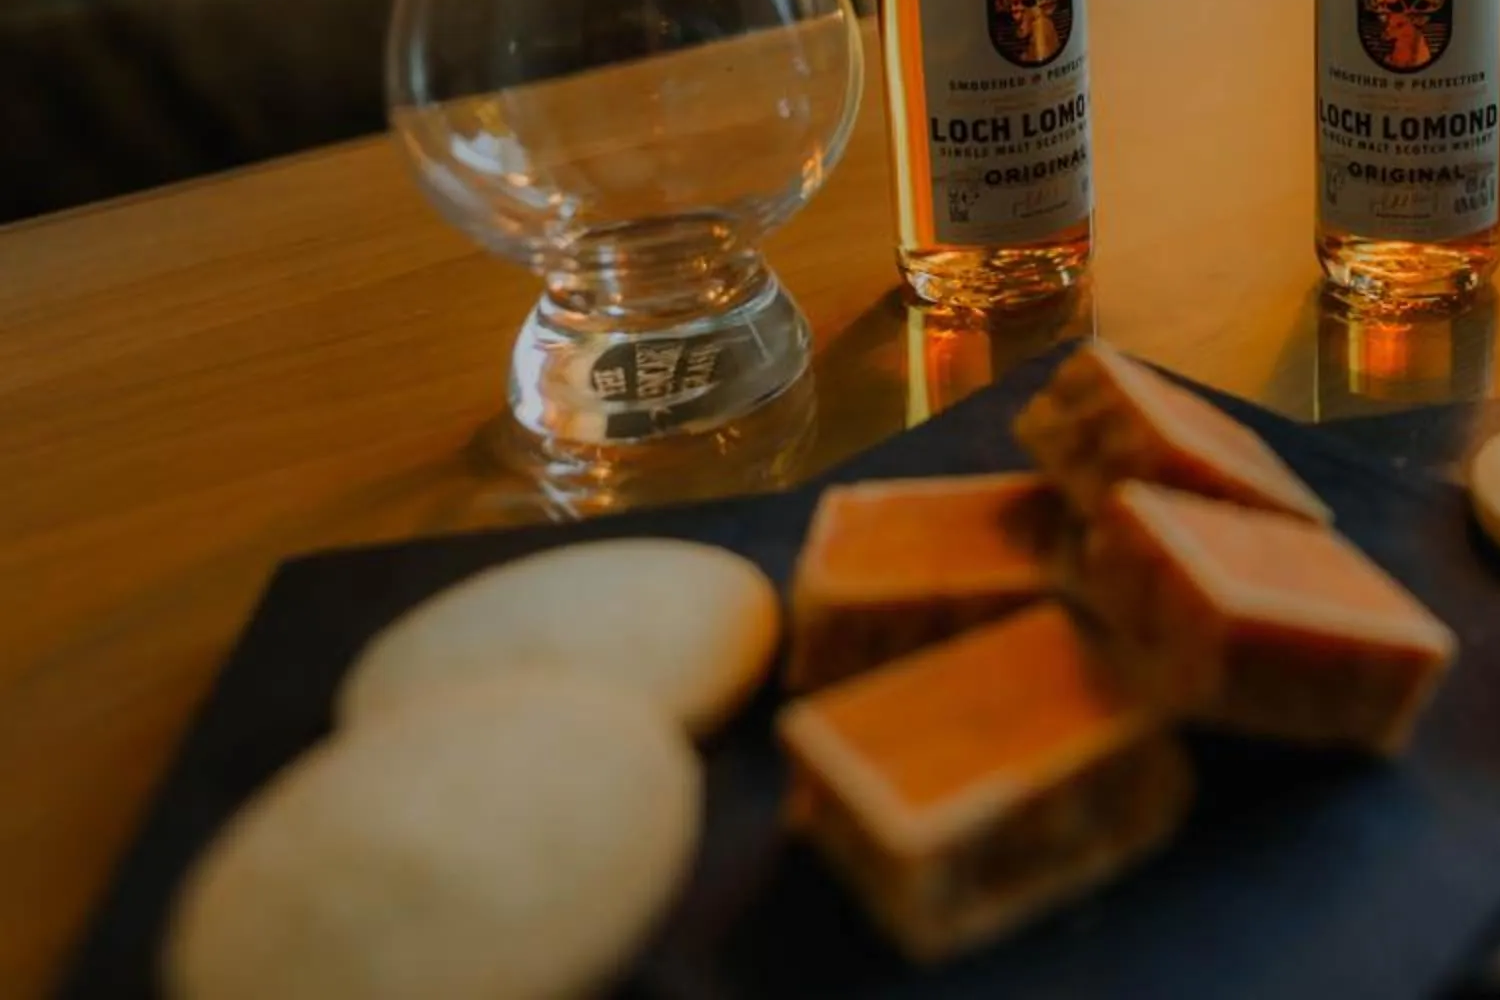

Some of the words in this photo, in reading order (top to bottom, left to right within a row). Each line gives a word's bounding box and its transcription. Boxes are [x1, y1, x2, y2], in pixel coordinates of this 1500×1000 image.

[930, 117, 1011, 144] LOCH
[1318, 96, 1372, 138] LOCH
[1382, 103, 1498, 142] LOMOND
[1347, 161, 1466, 184] ORIGINAL
